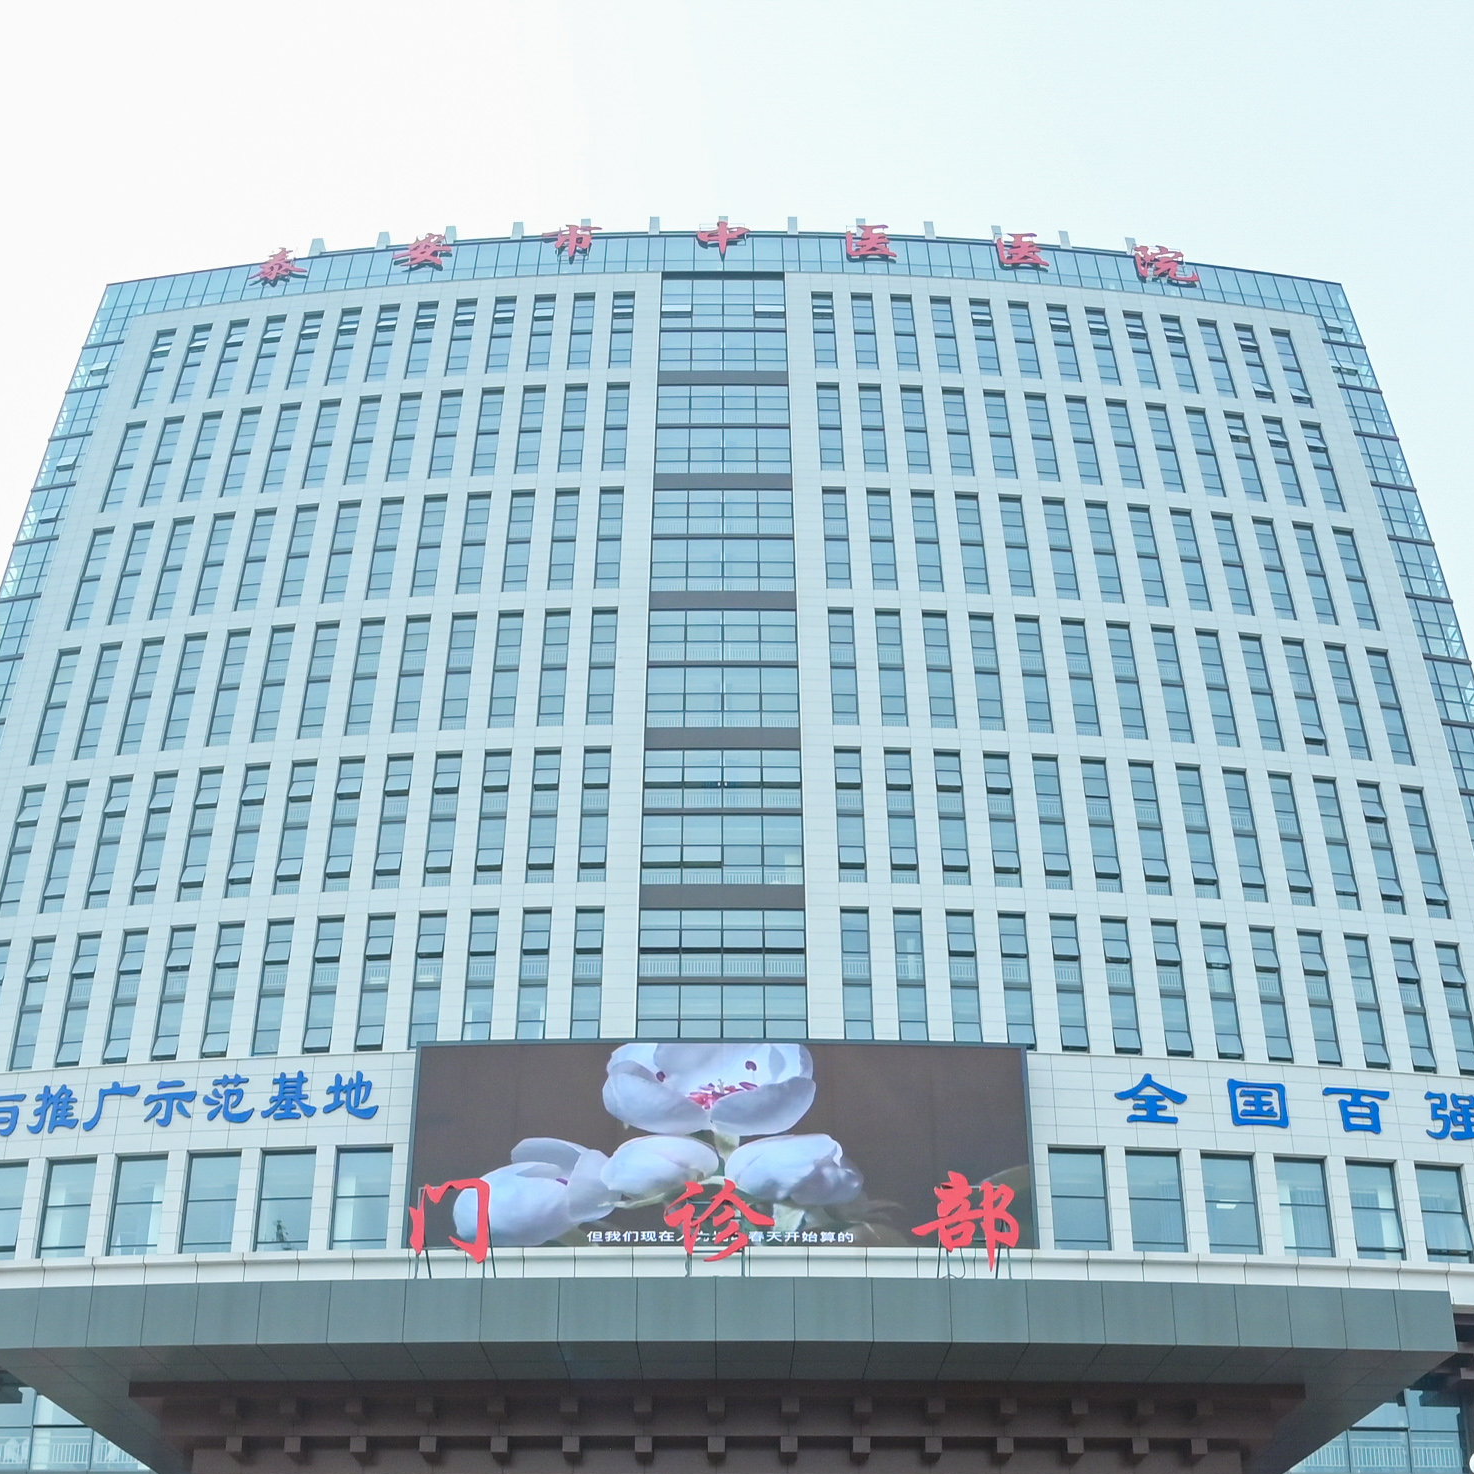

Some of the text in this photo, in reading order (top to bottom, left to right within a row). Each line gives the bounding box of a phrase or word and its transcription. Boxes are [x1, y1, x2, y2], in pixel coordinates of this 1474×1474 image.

[249, 222, 1200, 286] 泰安市中医医院
[408, 1171, 1021, 1272] 门诊部
